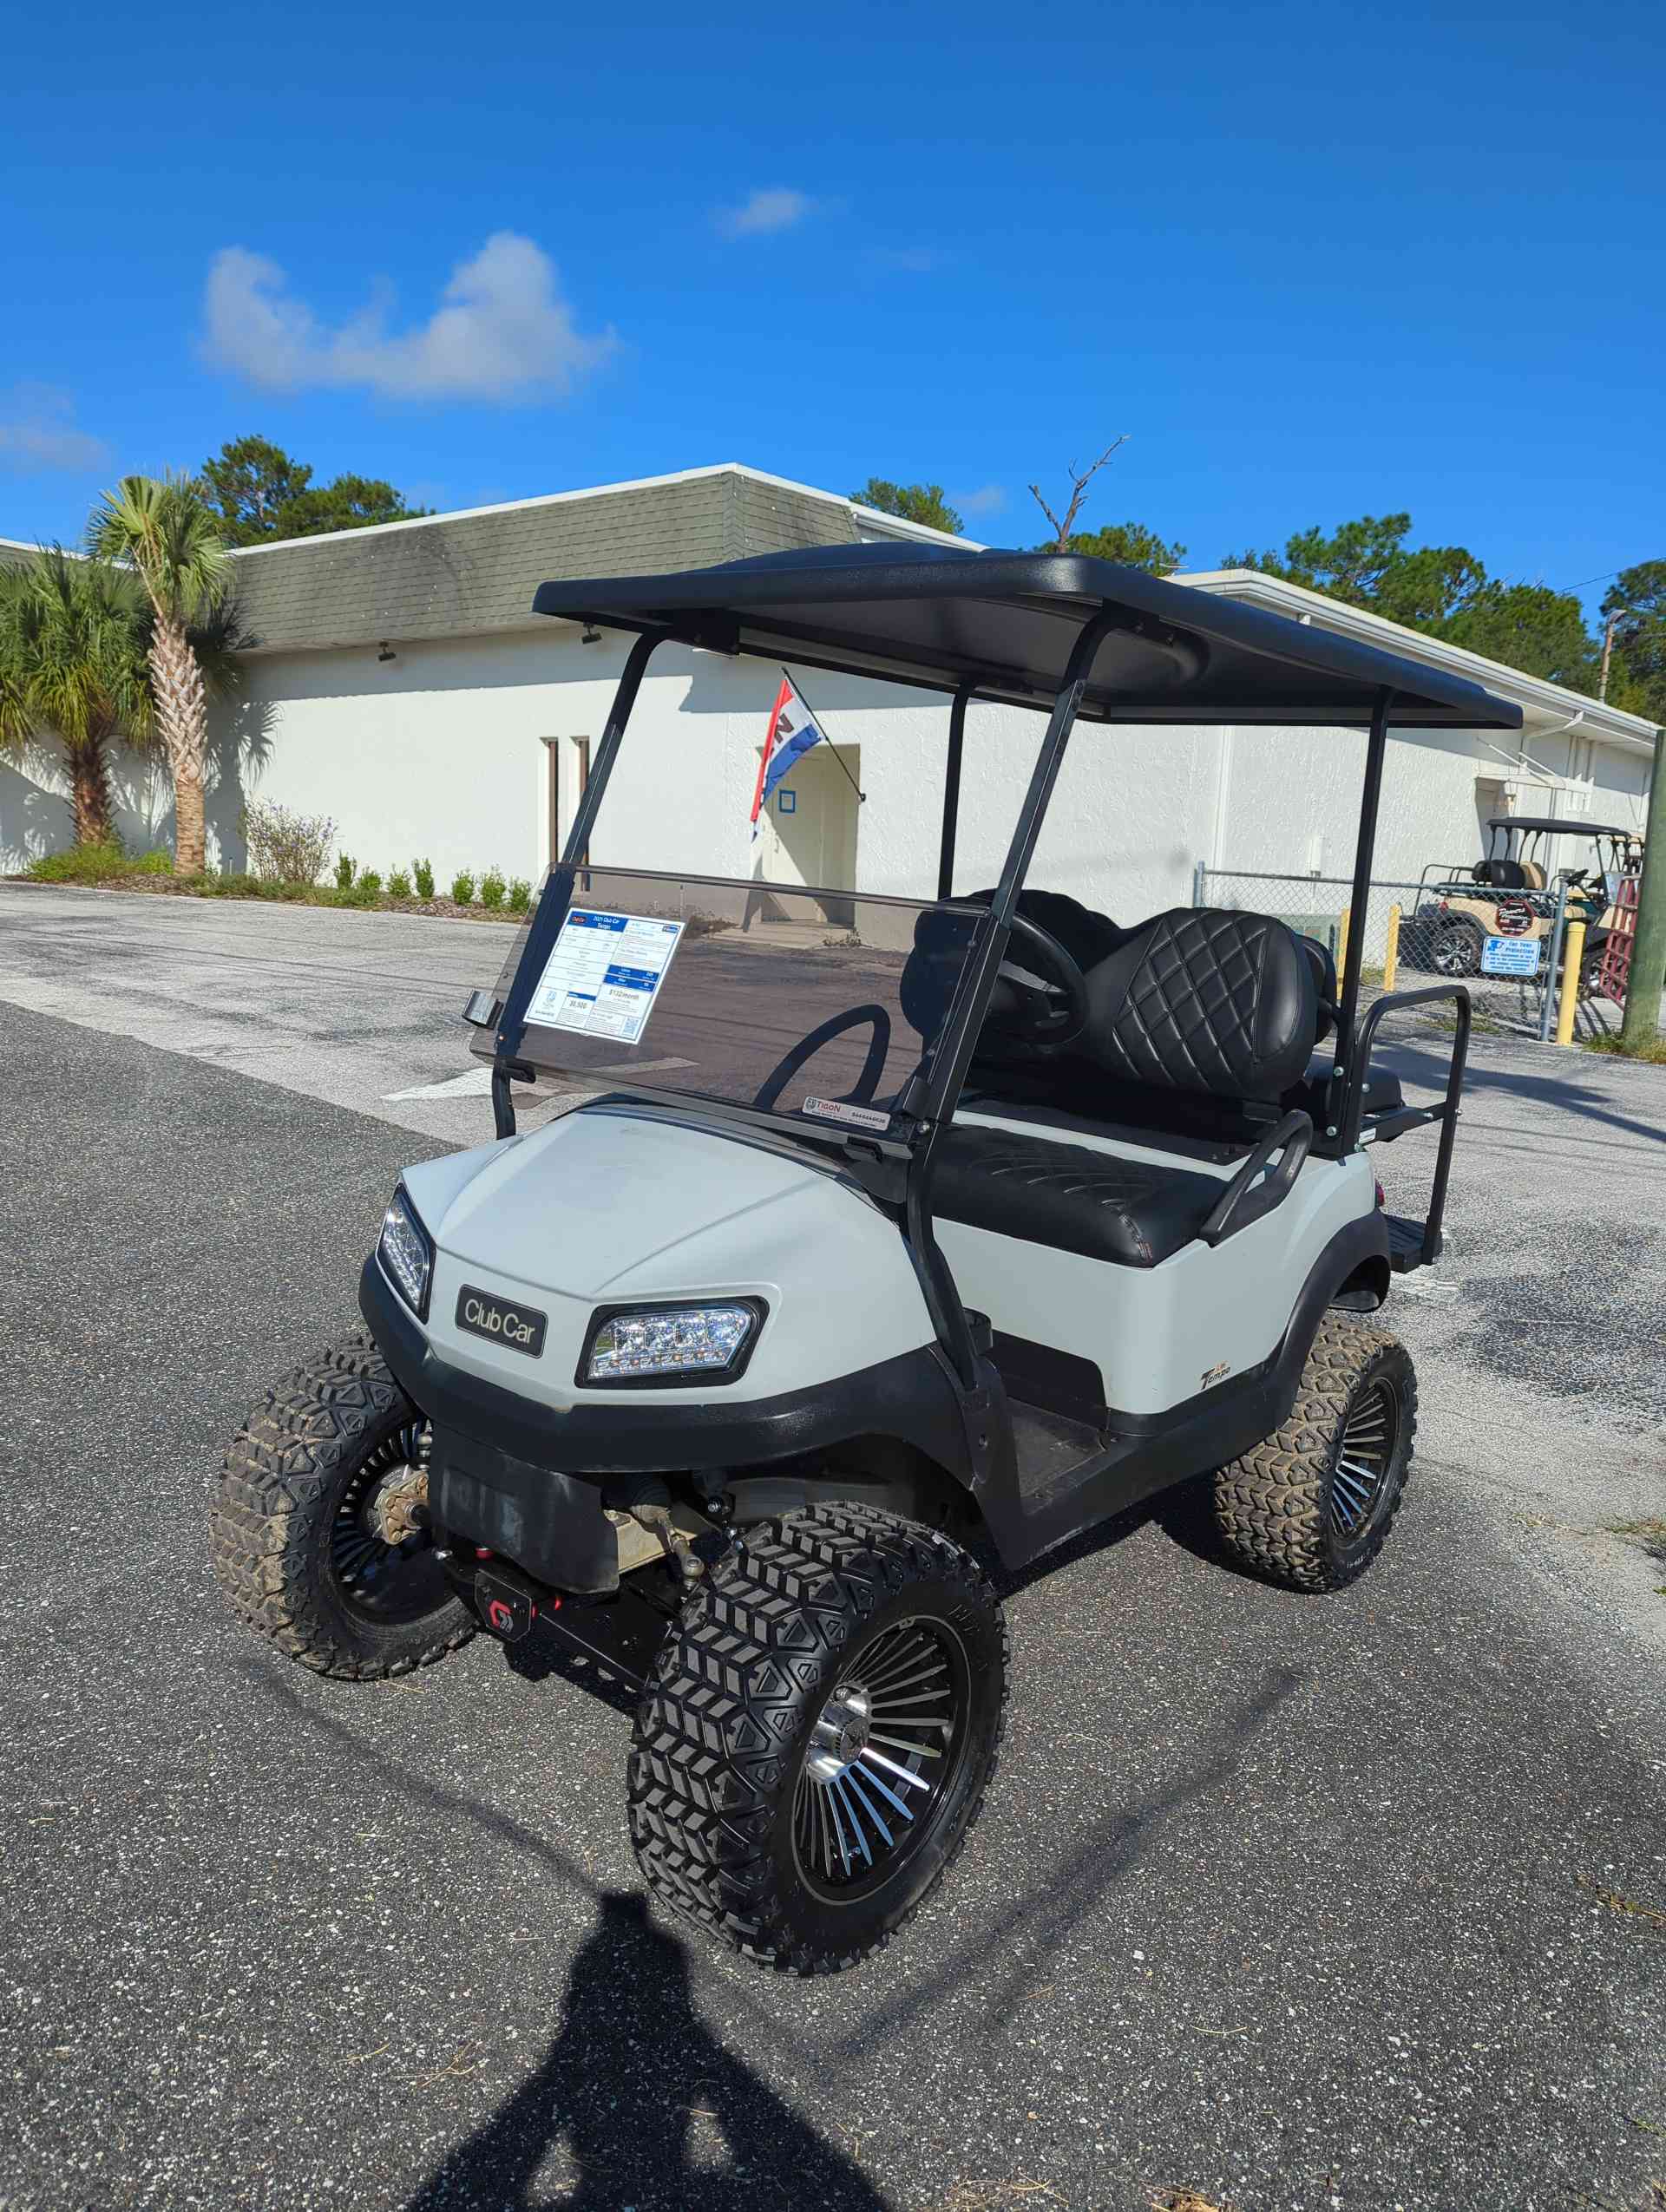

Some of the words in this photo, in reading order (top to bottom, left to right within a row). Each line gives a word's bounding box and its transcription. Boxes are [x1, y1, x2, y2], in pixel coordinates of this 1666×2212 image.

[464, 1299, 502, 1332] Club
[503, 1312, 535, 1344] Car
[1201, 1366, 1230, 1391] Tempo
